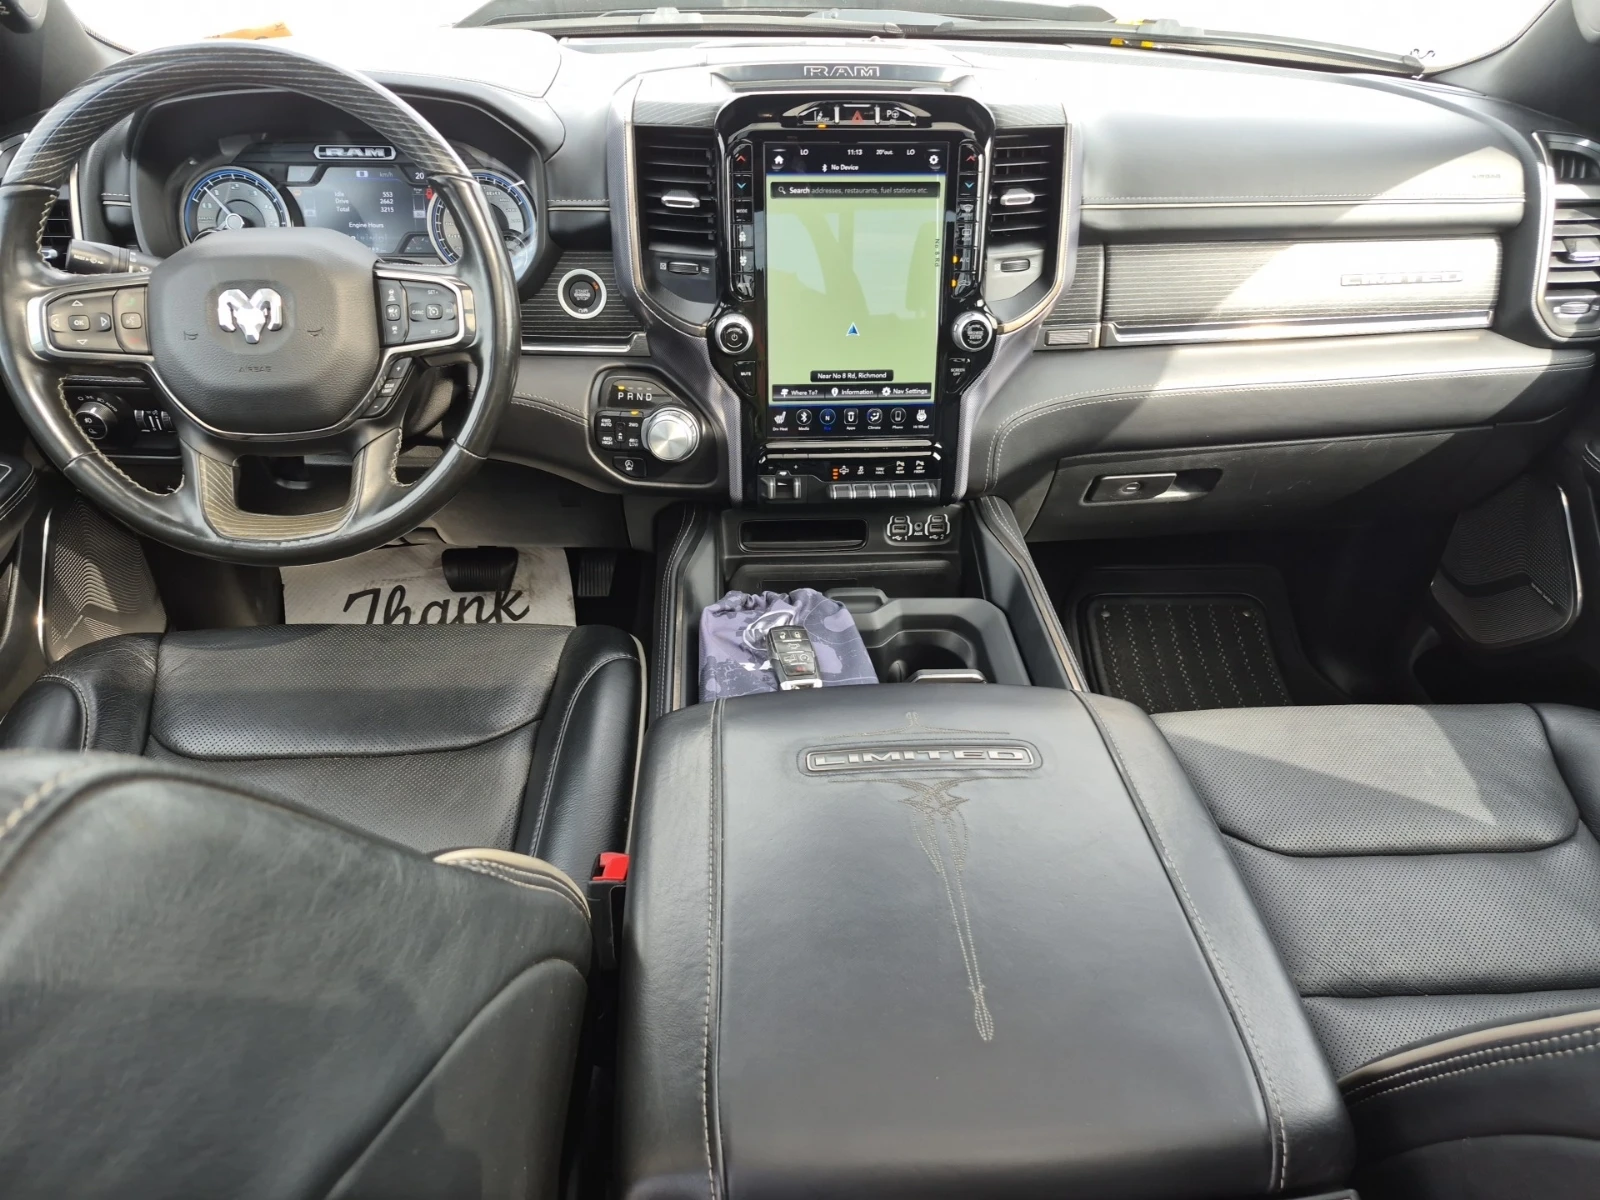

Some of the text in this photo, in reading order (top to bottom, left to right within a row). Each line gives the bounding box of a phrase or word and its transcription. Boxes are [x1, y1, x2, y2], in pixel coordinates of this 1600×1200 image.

[803, 65, 880, 77] RAM
[325, 148, 385, 158] RAM
[415, 172, 425, 180] 20
[789, 186, 810, 194] Search
[811, 186, 843, 195] addresses,
[844, 187, 879, 196] restaurants,
[880, 186, 892, 194] fuel
[349, 221, 367, 229] Engine
[848, 372, 858, 380] Rd,
[617, 392, 653, 401] P R N D
[343, 584, 530, 625] Thank
[814, 750, 1024, 767] LIMITED
